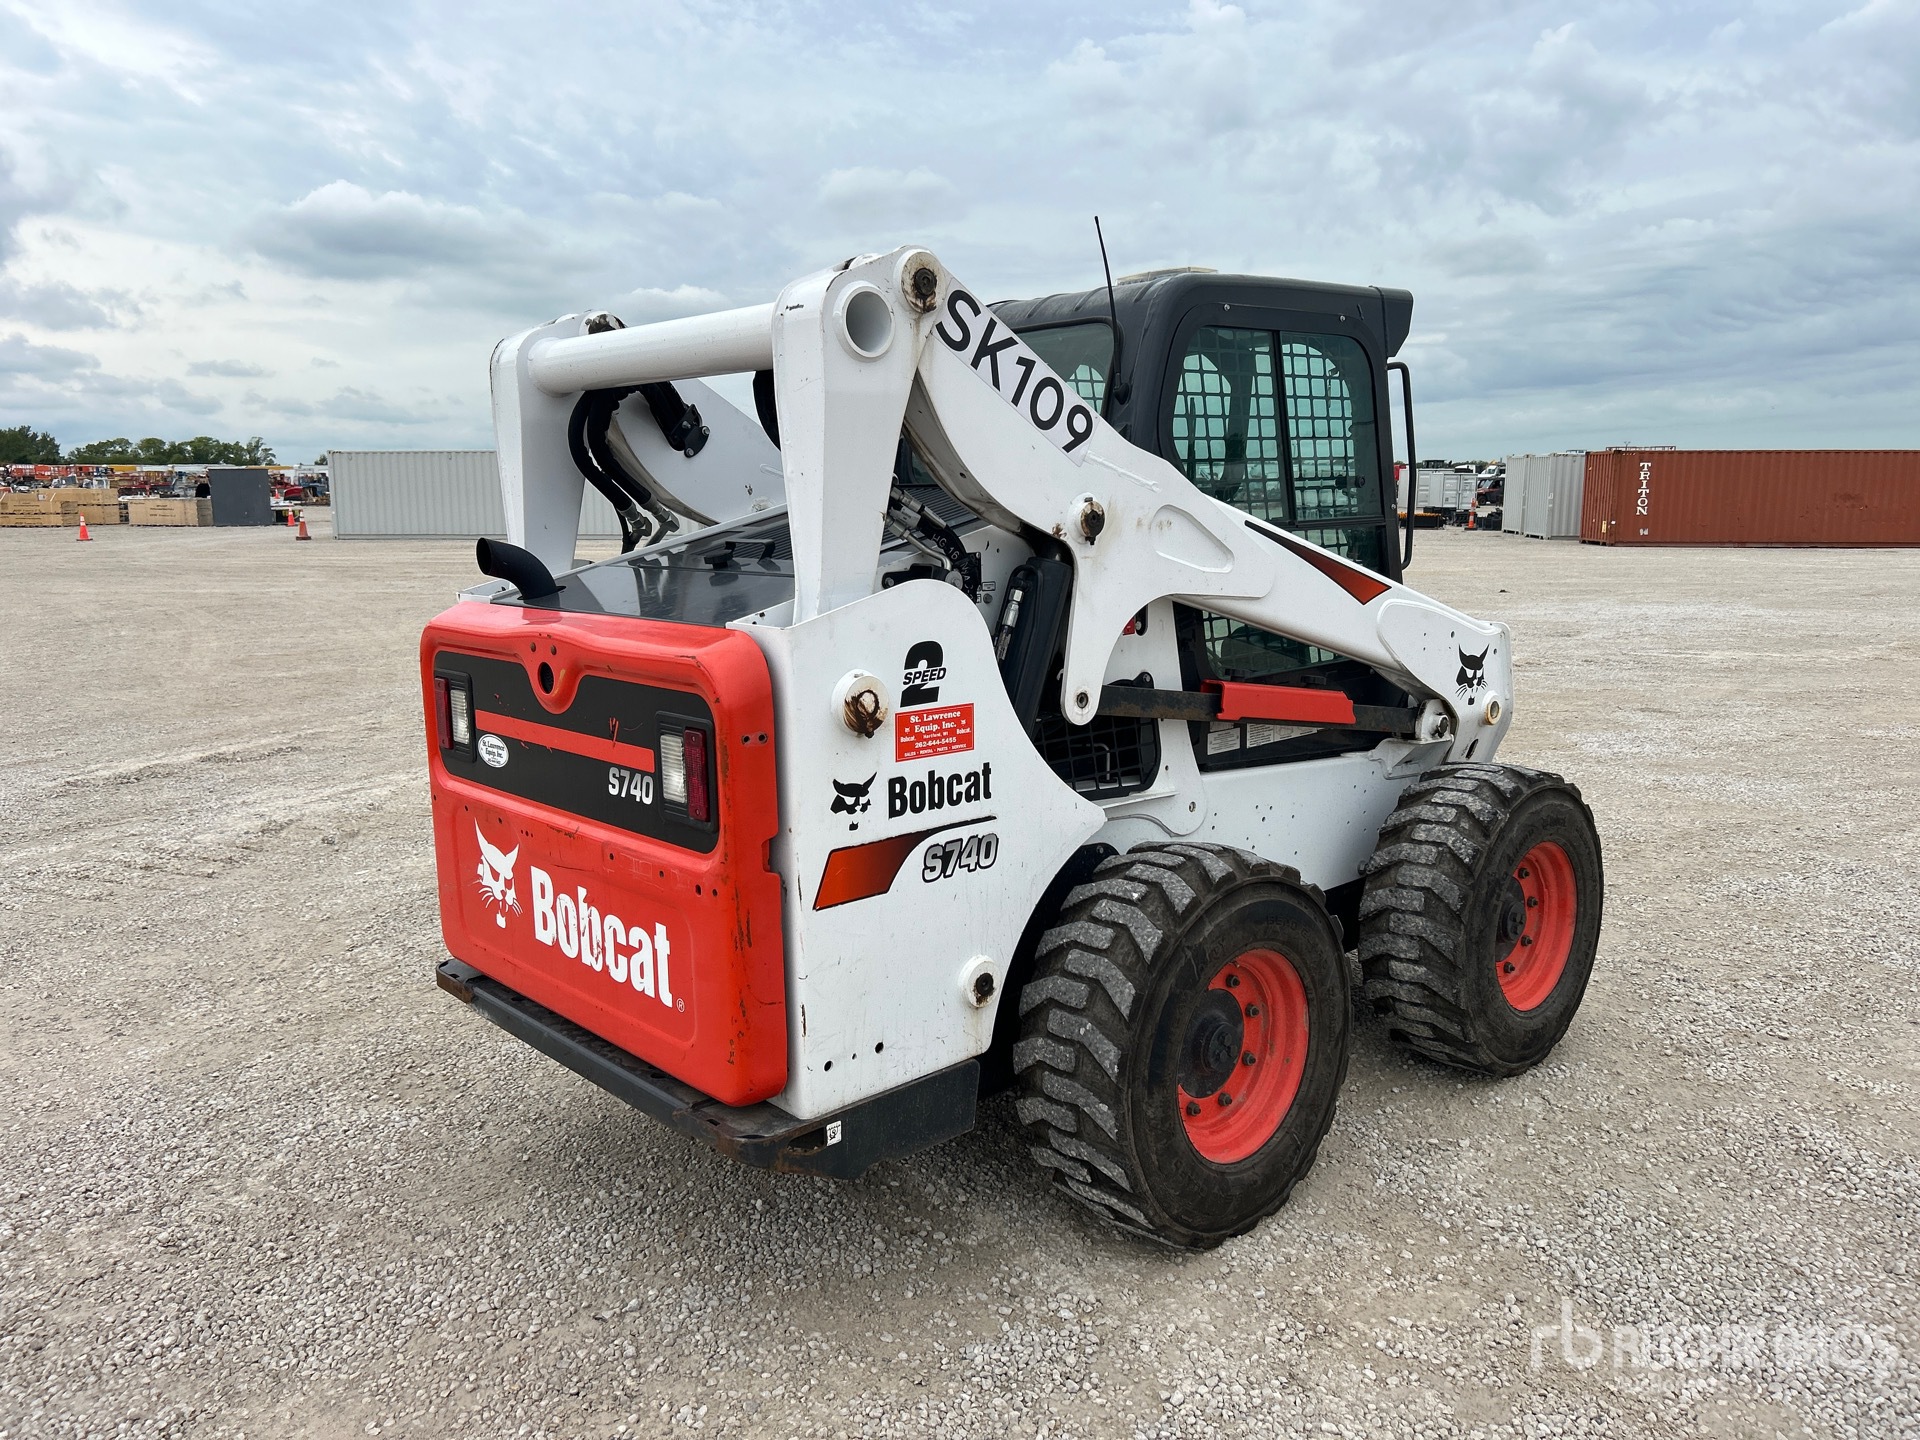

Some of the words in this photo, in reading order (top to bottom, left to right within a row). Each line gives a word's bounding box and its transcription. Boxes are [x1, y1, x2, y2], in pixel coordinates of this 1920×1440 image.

[935, 288, 1094, 454] SK109
[1635, 462, 1652, 516] TRITON
[902, 665, 947, 686] SPEED
[910, 715, 921, 723] St.
[924, 711, 961, 721] Lawrence
[915, 723, 940, 733] Equip.
[608, 766, 653, 805] S740
[888, 761, 992, 819] Bobcat
[922, 832, 998, 884] S740
[530, 865, 672, 1008] Bobcat
